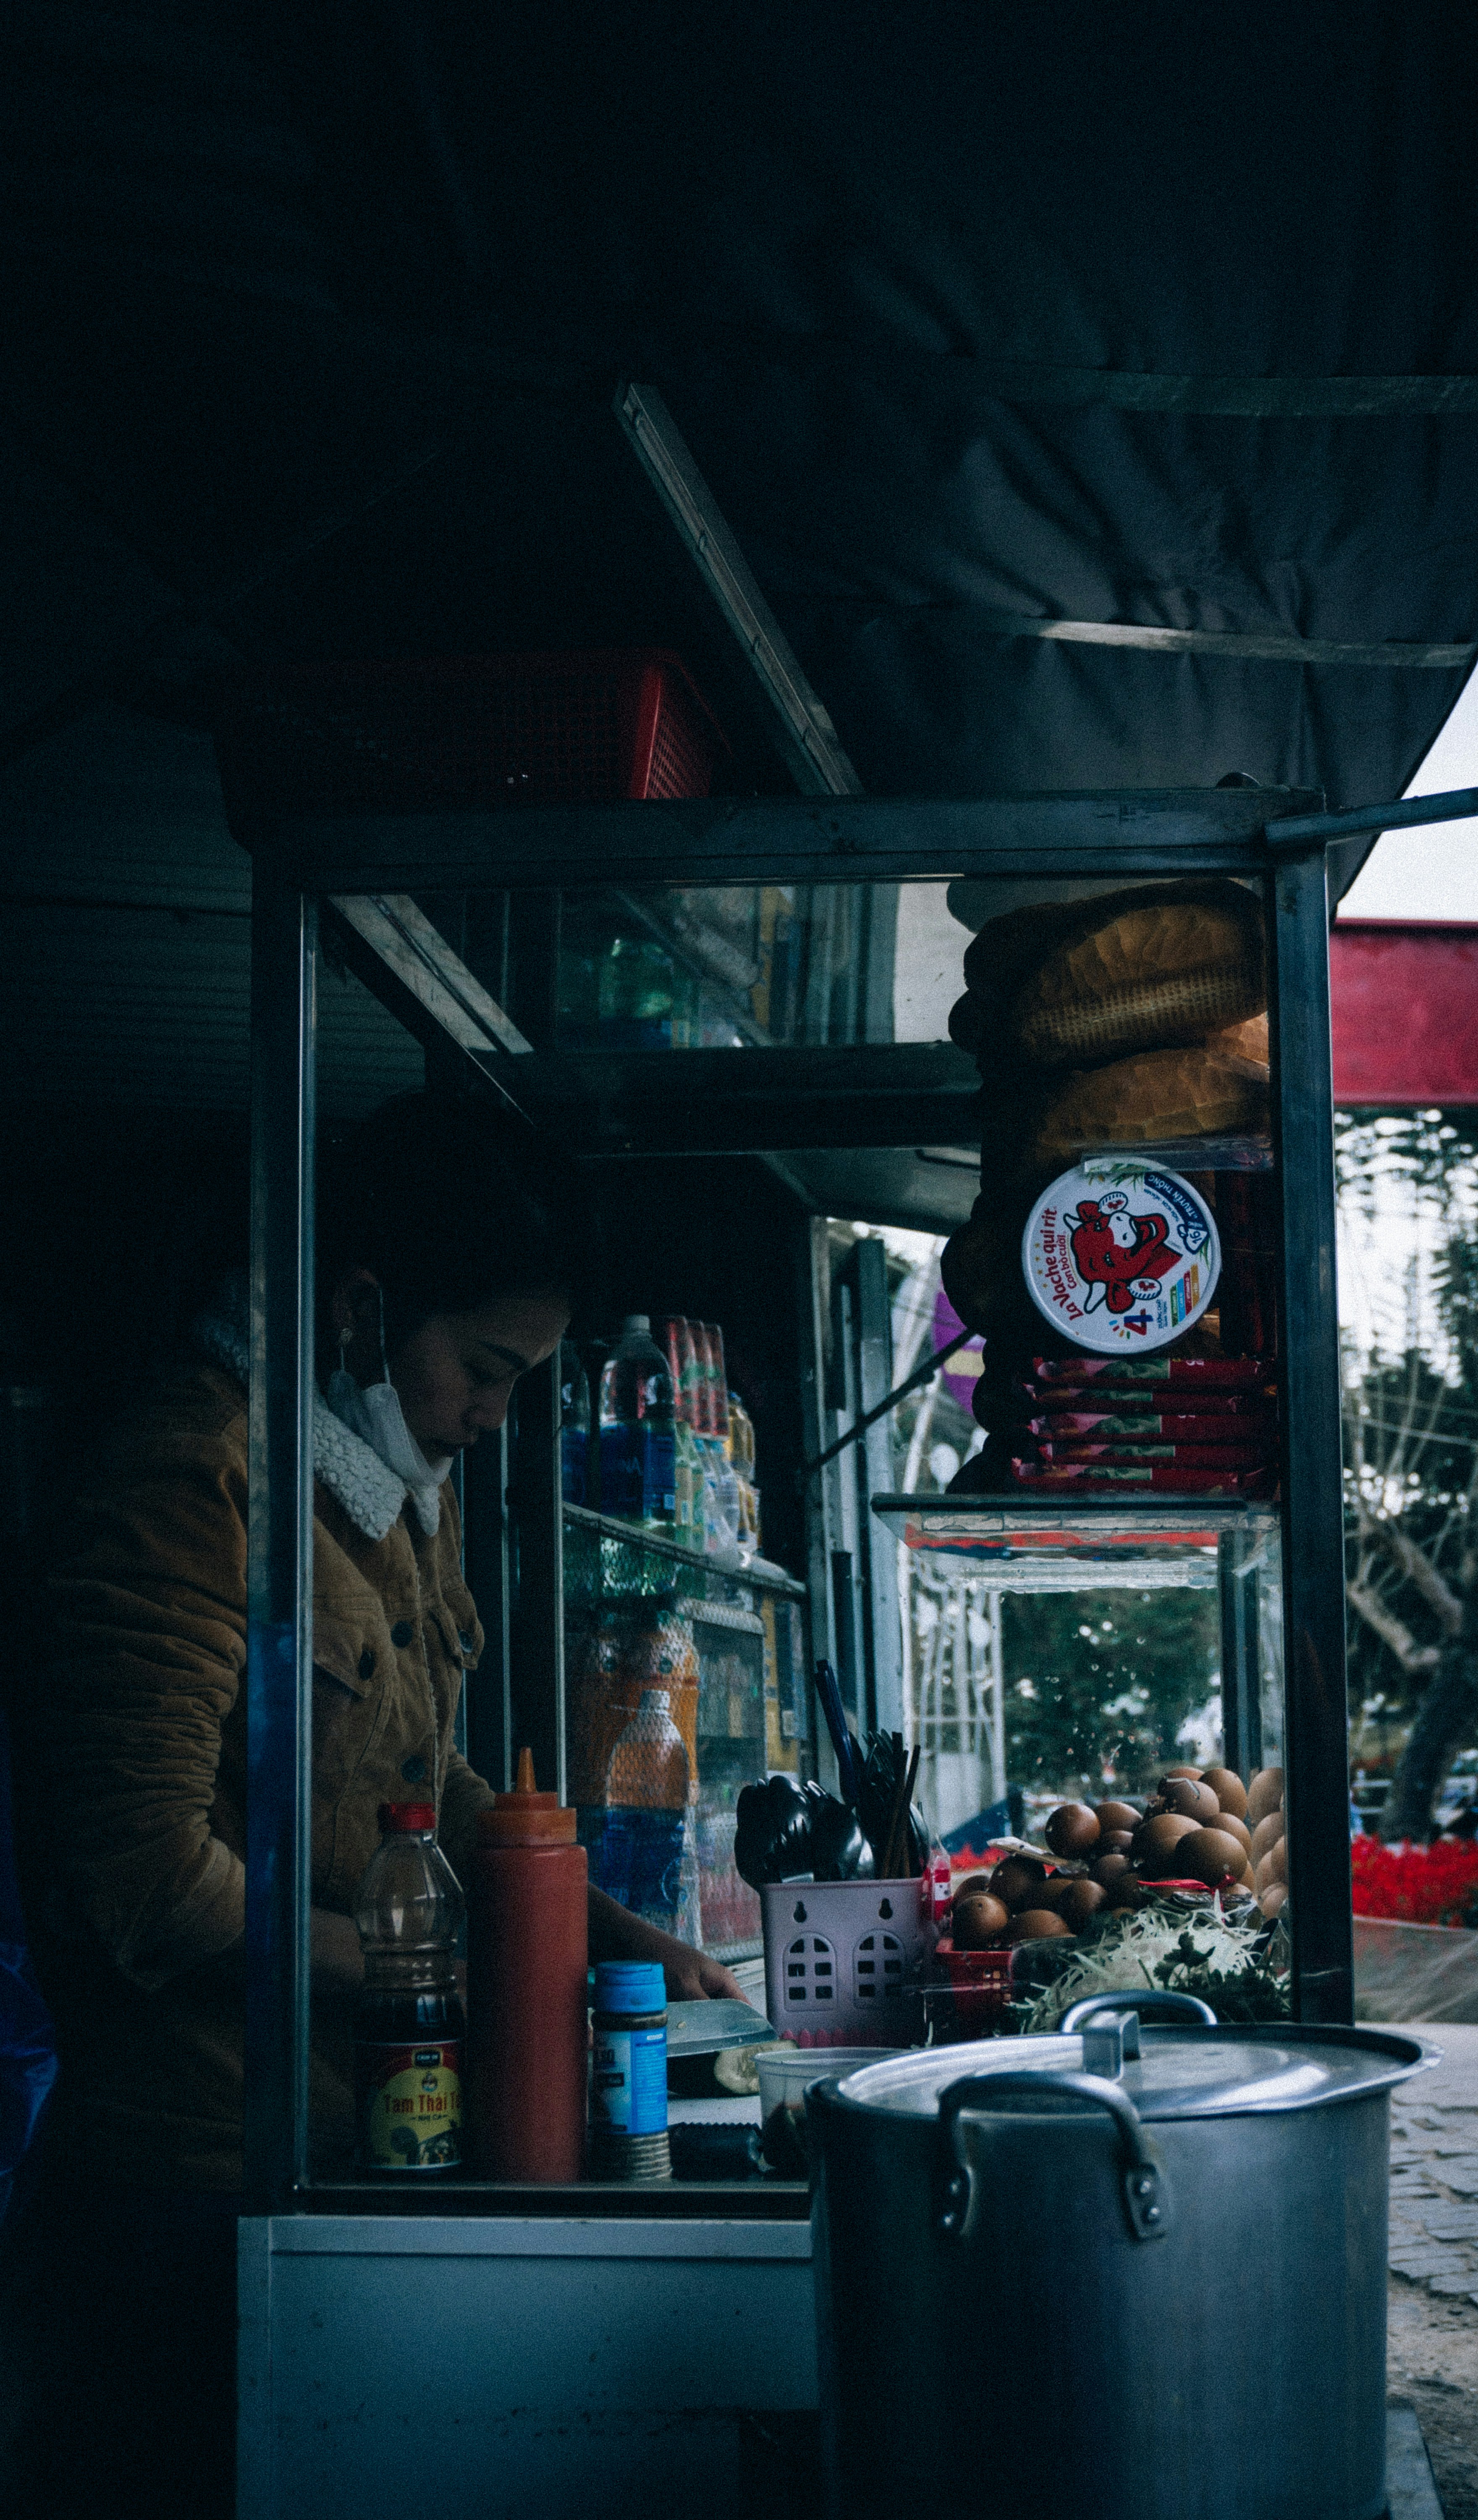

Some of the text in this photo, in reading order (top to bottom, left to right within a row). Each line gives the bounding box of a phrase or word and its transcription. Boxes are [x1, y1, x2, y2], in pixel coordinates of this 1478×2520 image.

[1148, 1175, 1173, 1194] THỐNG
[1056, 1234, 1067, 1256] cười
[1190, 1231, 1202, 1244] 16
[1040, 1208, 1084, 1320] La Vache qui rit
[1058, 1257, 1069, 1270] bò
[1124, 1308, 1153, 1336] 4
[384, 2093, 414, 2113] Tam
[419, 2092, 447, 2113] Thái
